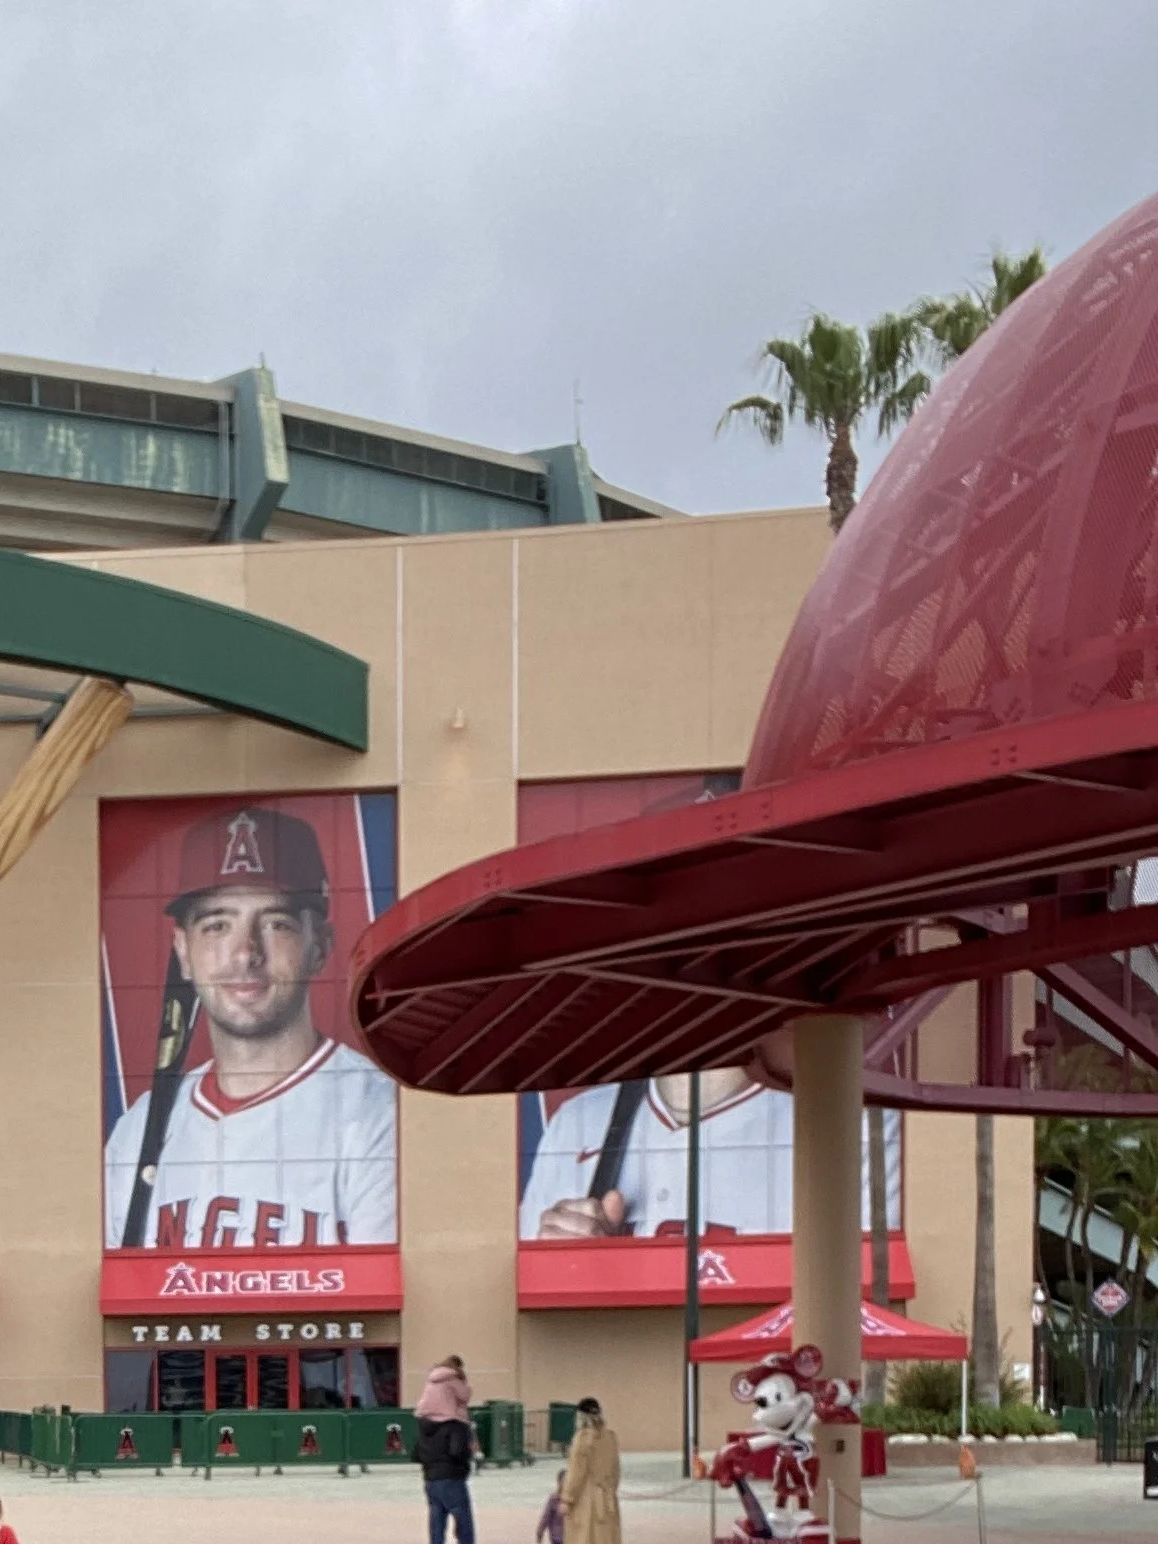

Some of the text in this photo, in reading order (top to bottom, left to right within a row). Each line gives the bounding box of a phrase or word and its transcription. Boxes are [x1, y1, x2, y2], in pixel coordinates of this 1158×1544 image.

[159, 1262, 345, 1296] ANGELS
[132, 1320, 366, 1344] TEAM STORE
